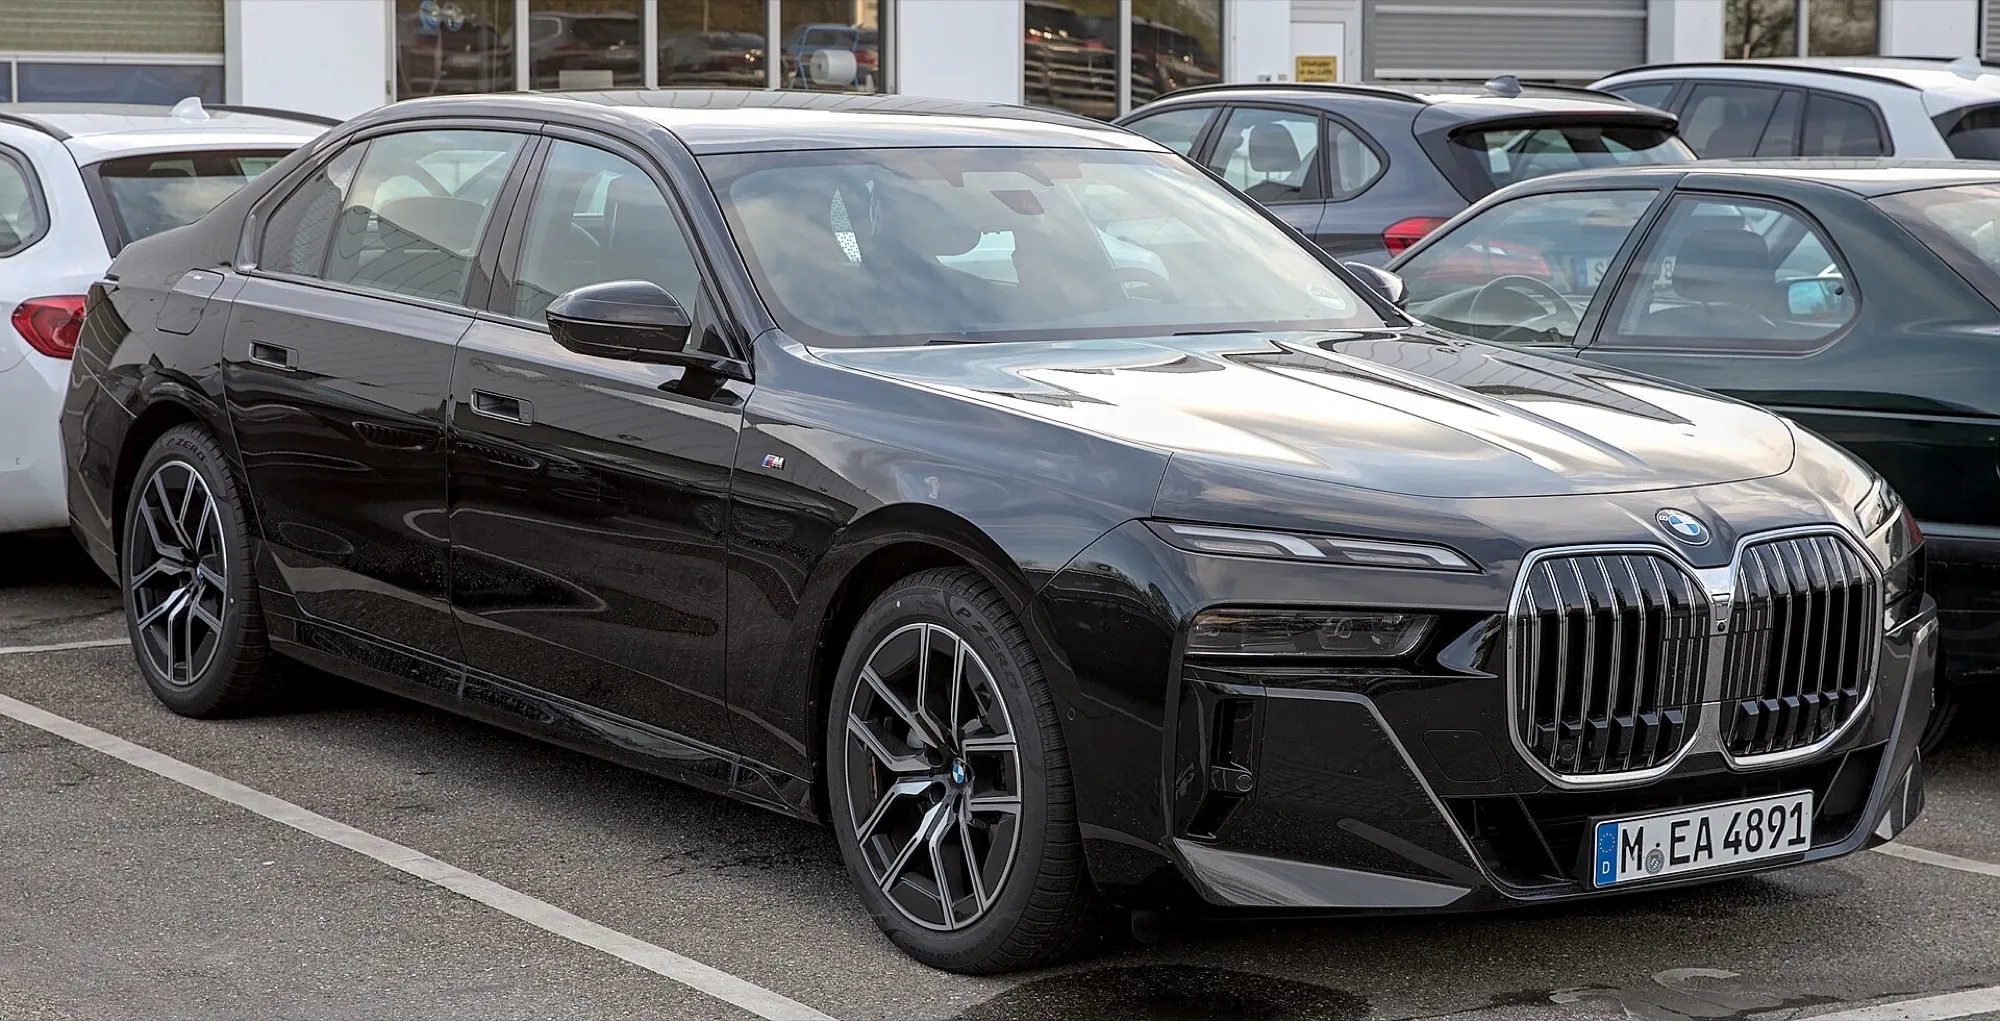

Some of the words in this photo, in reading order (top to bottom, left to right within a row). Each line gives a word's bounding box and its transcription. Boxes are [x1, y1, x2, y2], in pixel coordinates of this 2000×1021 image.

[175, 437, 206, 462] ZERO
[955, 606, 973, 618] P
[972, 620, 1020, 689] ZERO
[1620, 825, 1645, 874] M
[1669, 815, 1714, 867] EA
[1722, 801, 1807, 856] 4891
[1602, 860, 1611, 875] D
